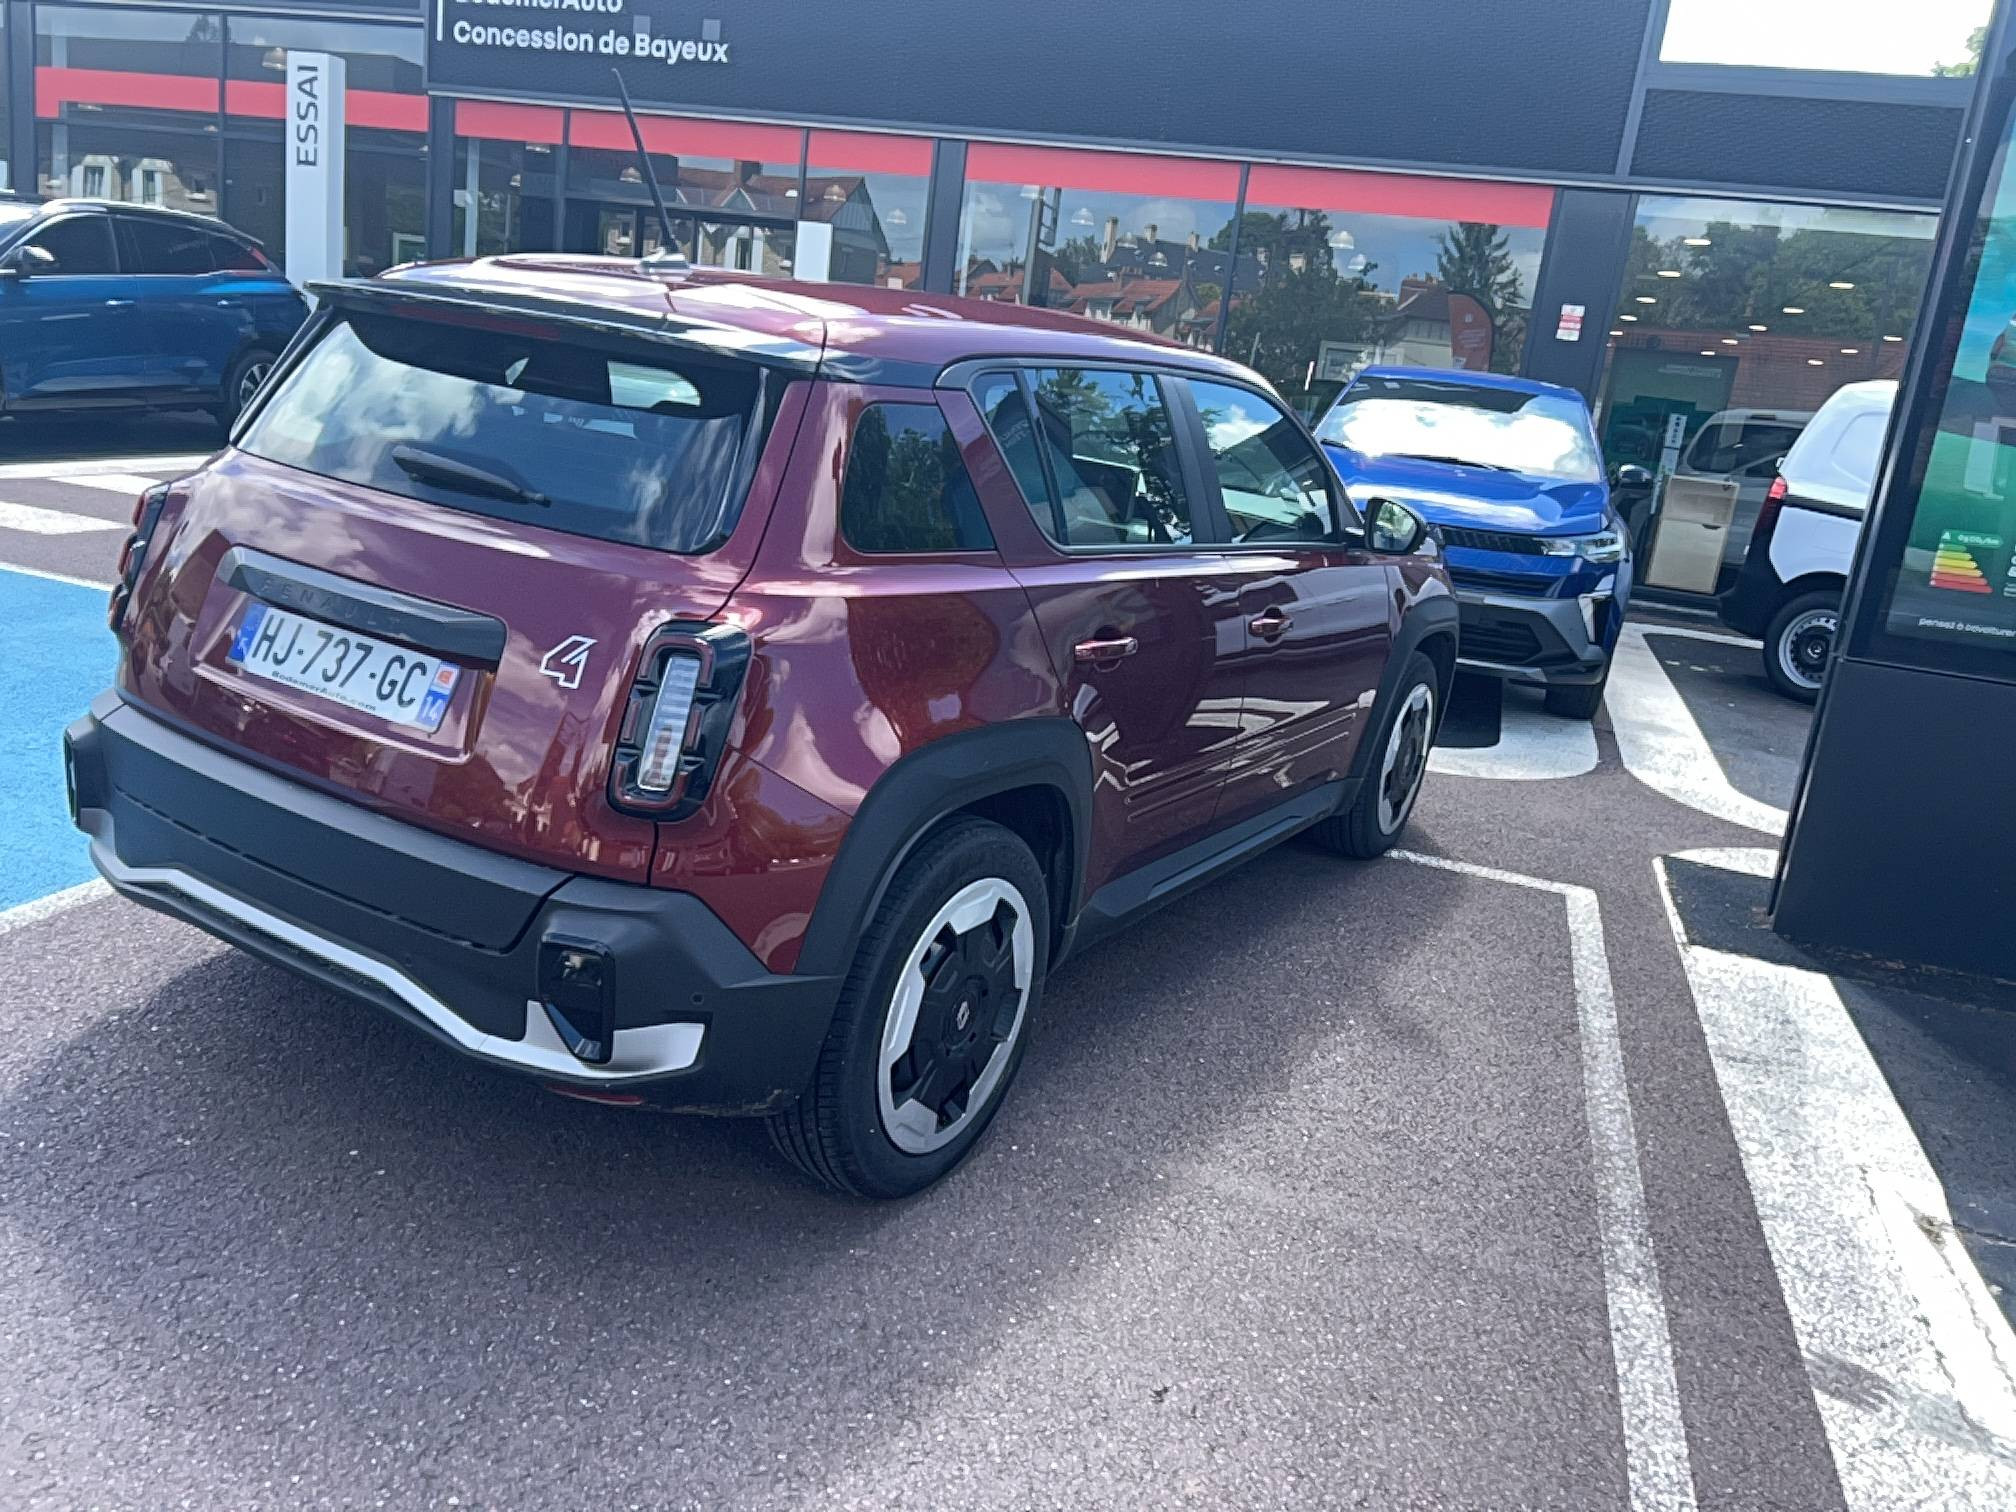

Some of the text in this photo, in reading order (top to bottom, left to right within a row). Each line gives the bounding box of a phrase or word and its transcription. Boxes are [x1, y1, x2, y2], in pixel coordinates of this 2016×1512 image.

[453, 21, 729, 64] Concession de Bayeux
[296, 65, 319, 166] ESSAI
[251, 614, 428, 708] HJ-737-GC
[422, 697, 443, 721] 14
